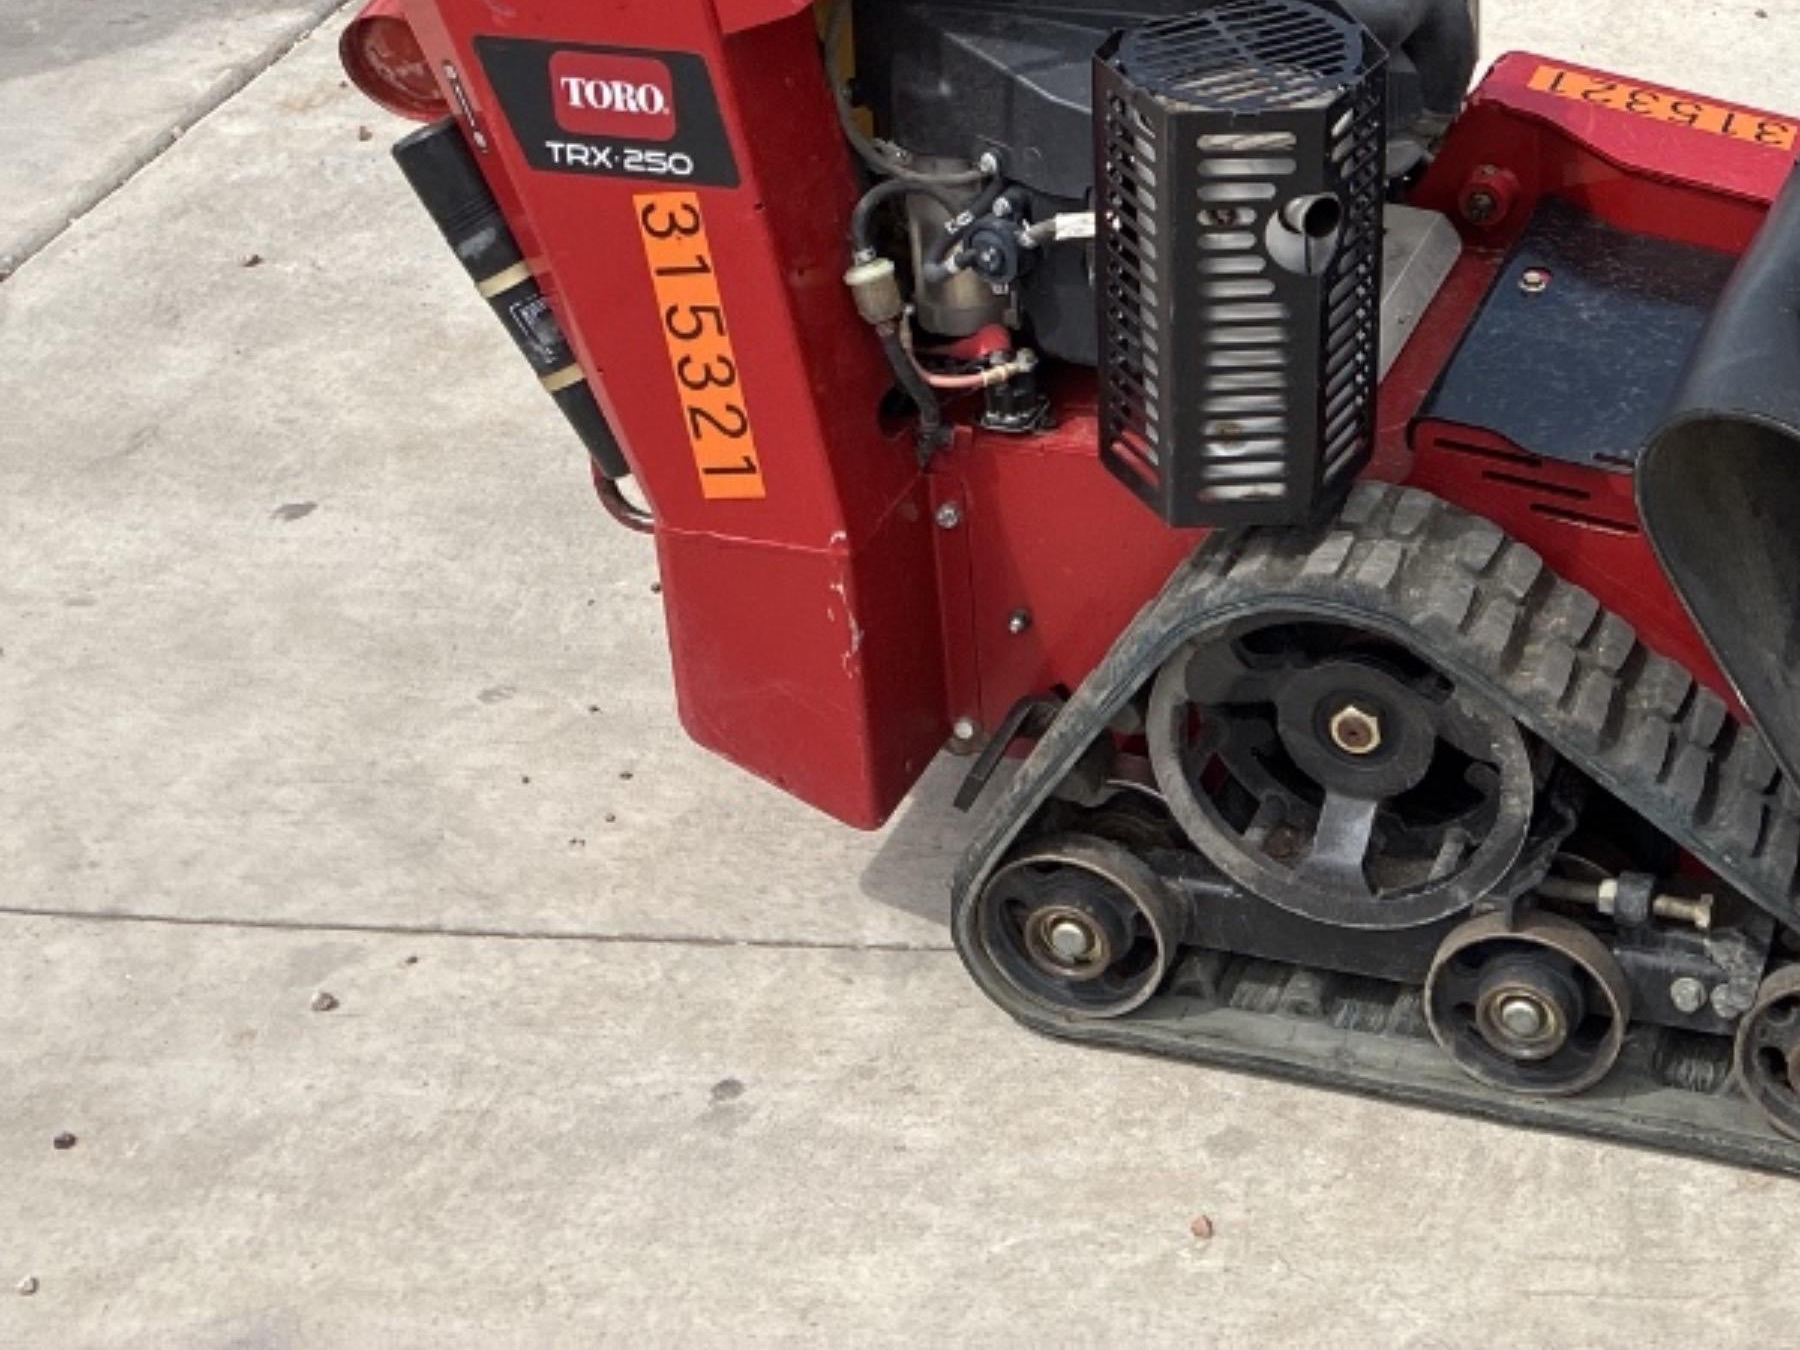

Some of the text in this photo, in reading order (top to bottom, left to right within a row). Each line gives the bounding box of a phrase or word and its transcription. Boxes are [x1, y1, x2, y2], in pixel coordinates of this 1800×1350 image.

[560, 76, 665, 115] TORO
[1549, 70, 1790, 145] 315321
[640, 201, 758, 475] 315321
